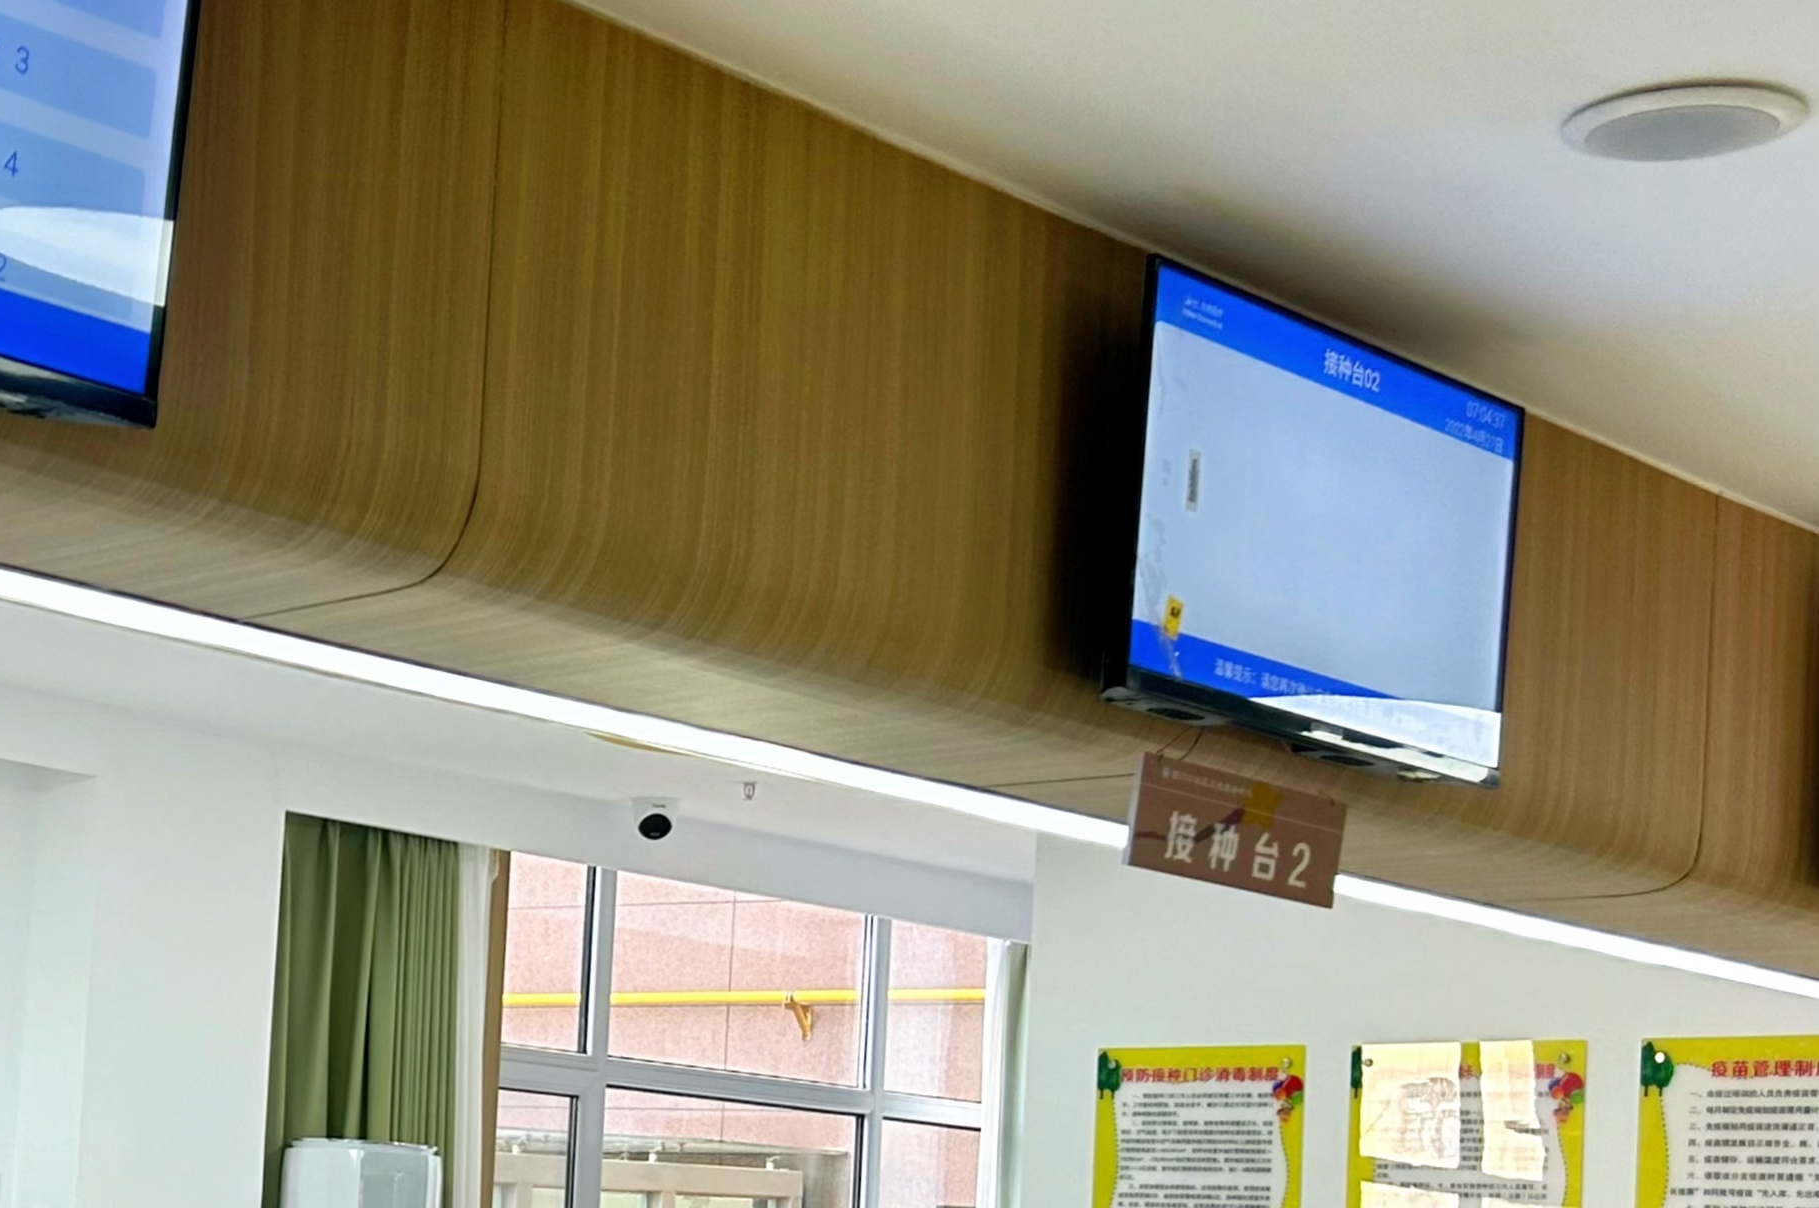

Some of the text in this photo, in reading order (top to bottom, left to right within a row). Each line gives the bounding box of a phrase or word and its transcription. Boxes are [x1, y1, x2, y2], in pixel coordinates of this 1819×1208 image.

[1323, 348, 1381, 393] 接种台02
[1164, 810, 1312, 889] 接种台2
[1711, 1059, 1819, 1077] 疫苗管理制
